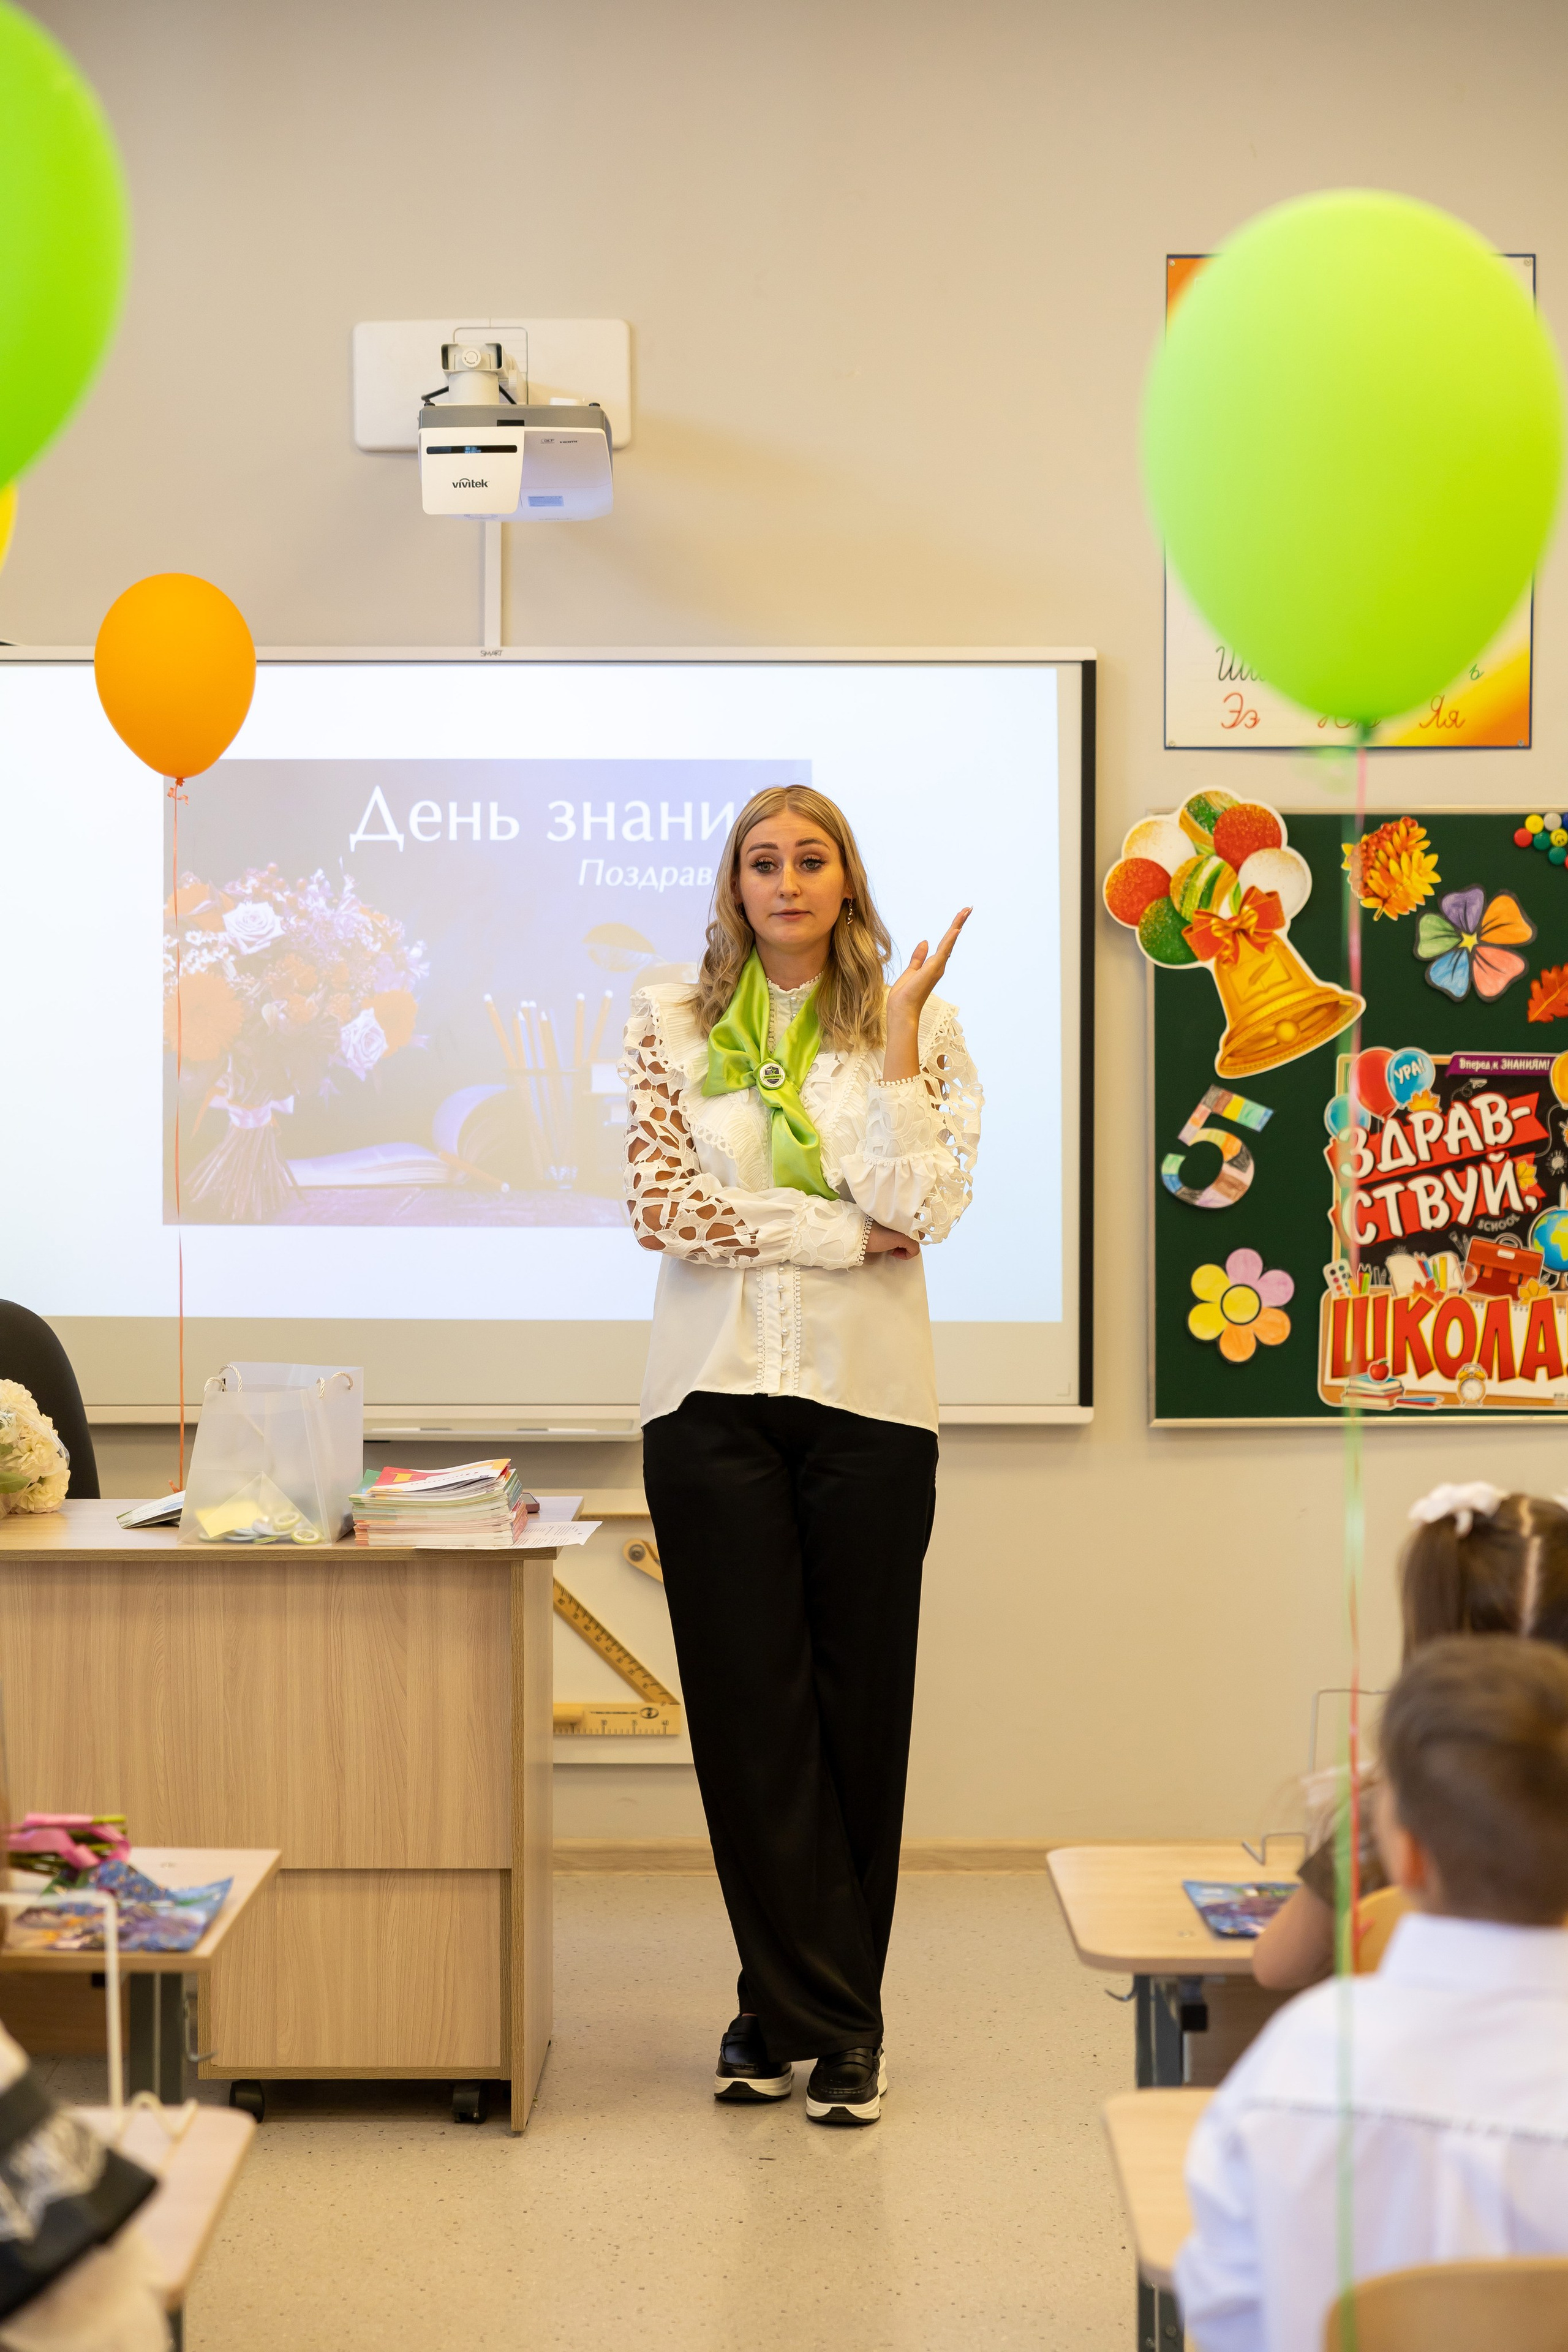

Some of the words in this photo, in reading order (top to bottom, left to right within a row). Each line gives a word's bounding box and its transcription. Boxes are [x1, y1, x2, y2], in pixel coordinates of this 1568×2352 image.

[452, 478, 488, 488] vivitek
[1221, 692, 1260, 729] Ээ
[1419, 695, 1466, 729] Яя
[350, 785, 520, 852] День
[547, 789, 755, 842] знани
[578, 859, 715, 892] Поздрав
[1394, 1057, 1425, 1084] УРА!
[1501, 1058, 1550, 1071] ЗНАНИЯМ!
[1161, 1084, 1274, 1208] 5
[1339, 1093, 1531, 1178] ЗДРАВ-
[1341, 1152, 1538, 1245] СТВУЙ,
[1477, 1213, 1520, 1232] SCHOOL
[1332, 1294, 1568, 1382] ШКОЛА
